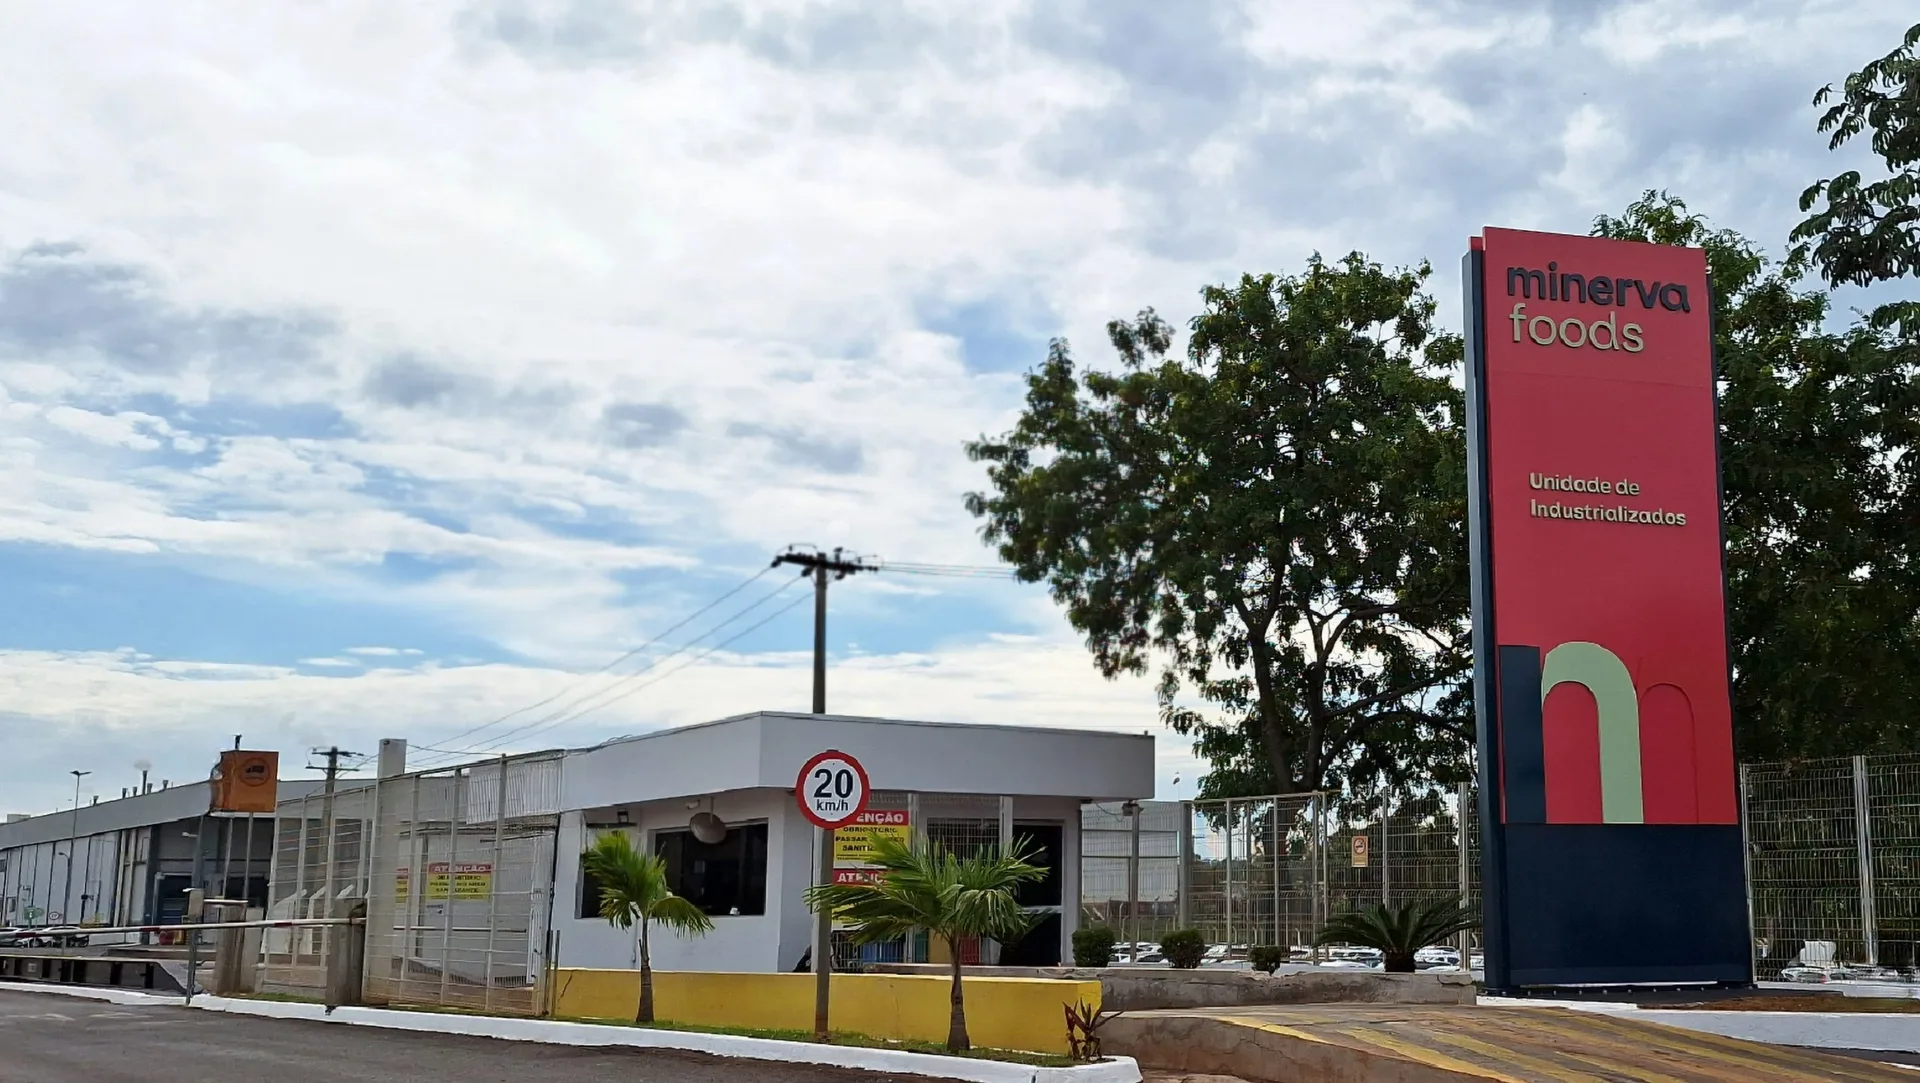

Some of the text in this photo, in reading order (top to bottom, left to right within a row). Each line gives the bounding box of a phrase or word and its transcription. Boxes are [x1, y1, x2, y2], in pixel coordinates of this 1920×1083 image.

[1507, 261, 1690, 313] minerva
[1509, 303, 1644, 352] foods
[1529, 472, 1640, 496] Unidade de
[1530, 499, 1687, 526] Industrializados
[813, 768, 854, 799] 20
[816, 799, 849, 812] km/h
[856, 812, 904, 825] ENÇÃO
